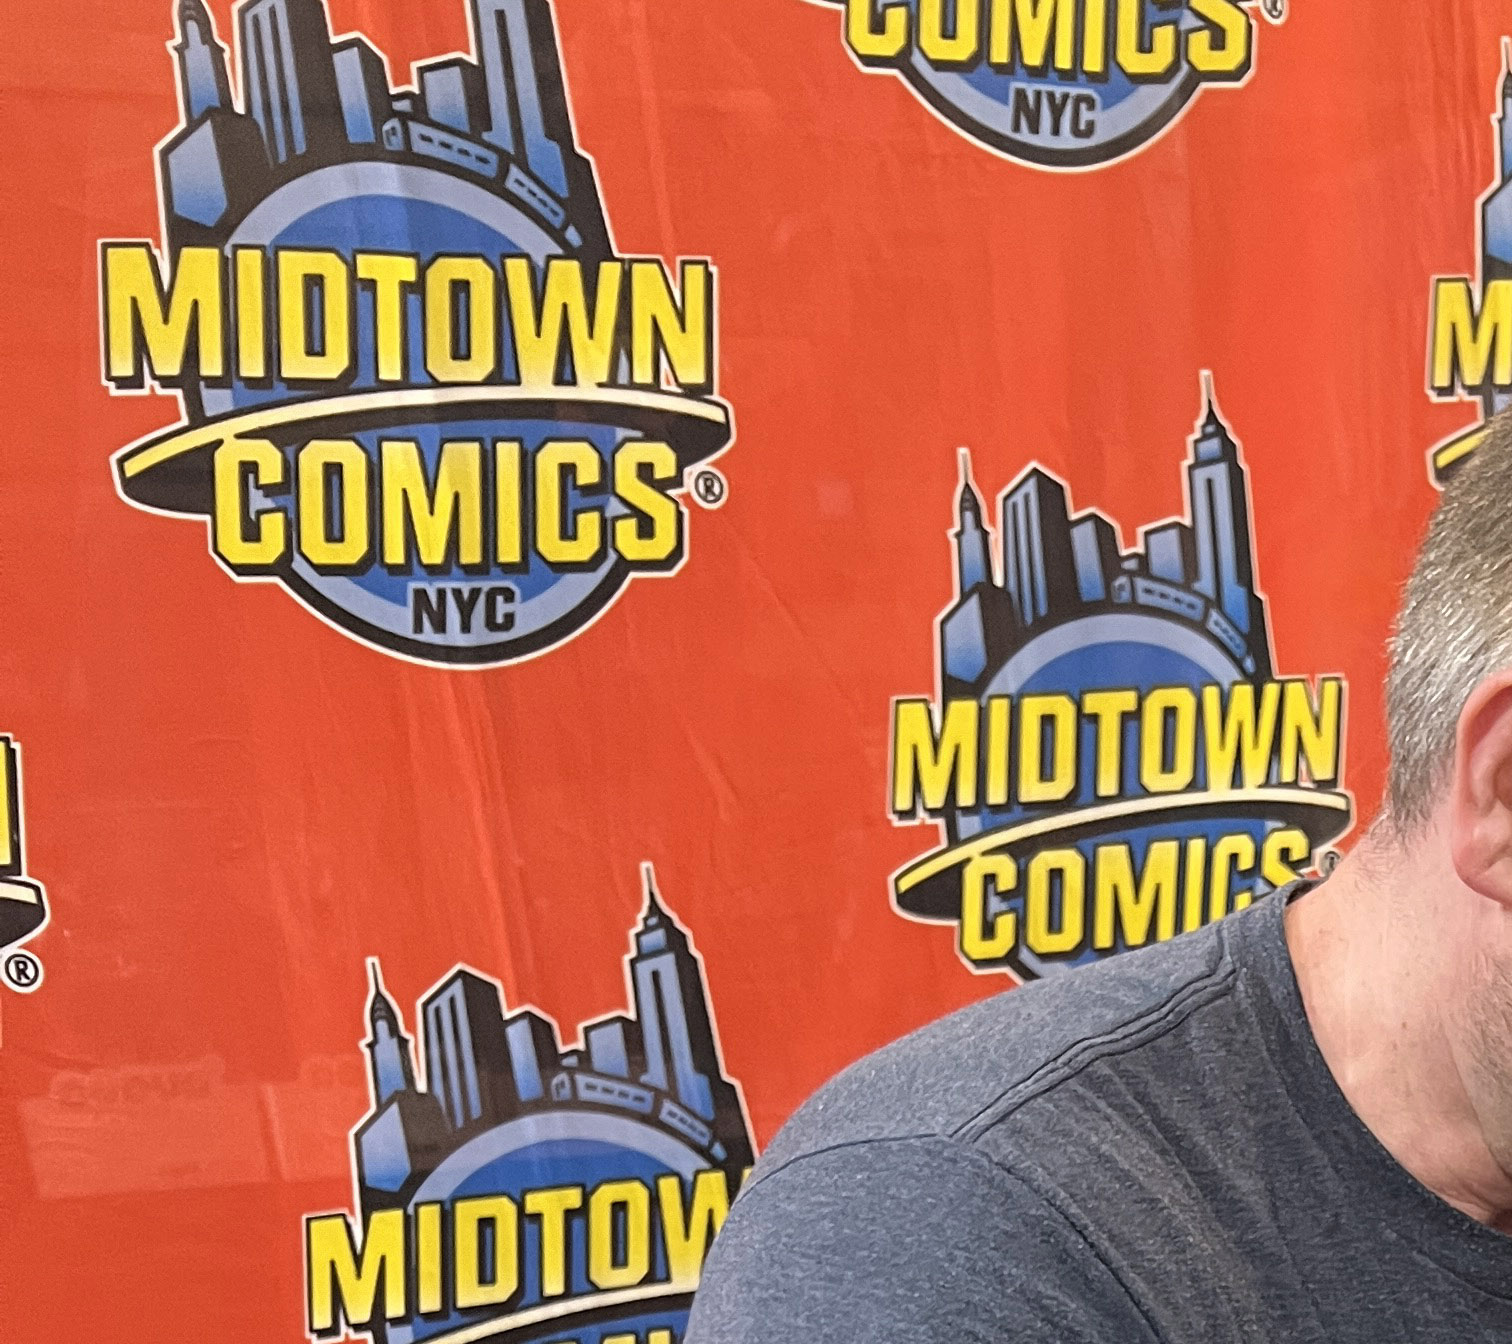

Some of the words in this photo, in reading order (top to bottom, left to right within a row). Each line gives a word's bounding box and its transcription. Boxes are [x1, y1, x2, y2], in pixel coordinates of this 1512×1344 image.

[1011, 88, 1096, 139] NYC
[102, 245, 711, 386] MIDTOWN
[213, 437, 688, 568] COMICS
[412, 586, 516, 635] NYC
[892, 677, 1341, 812] MIDTOWN
[308, 1168, 753, 1332] MIDTOW
